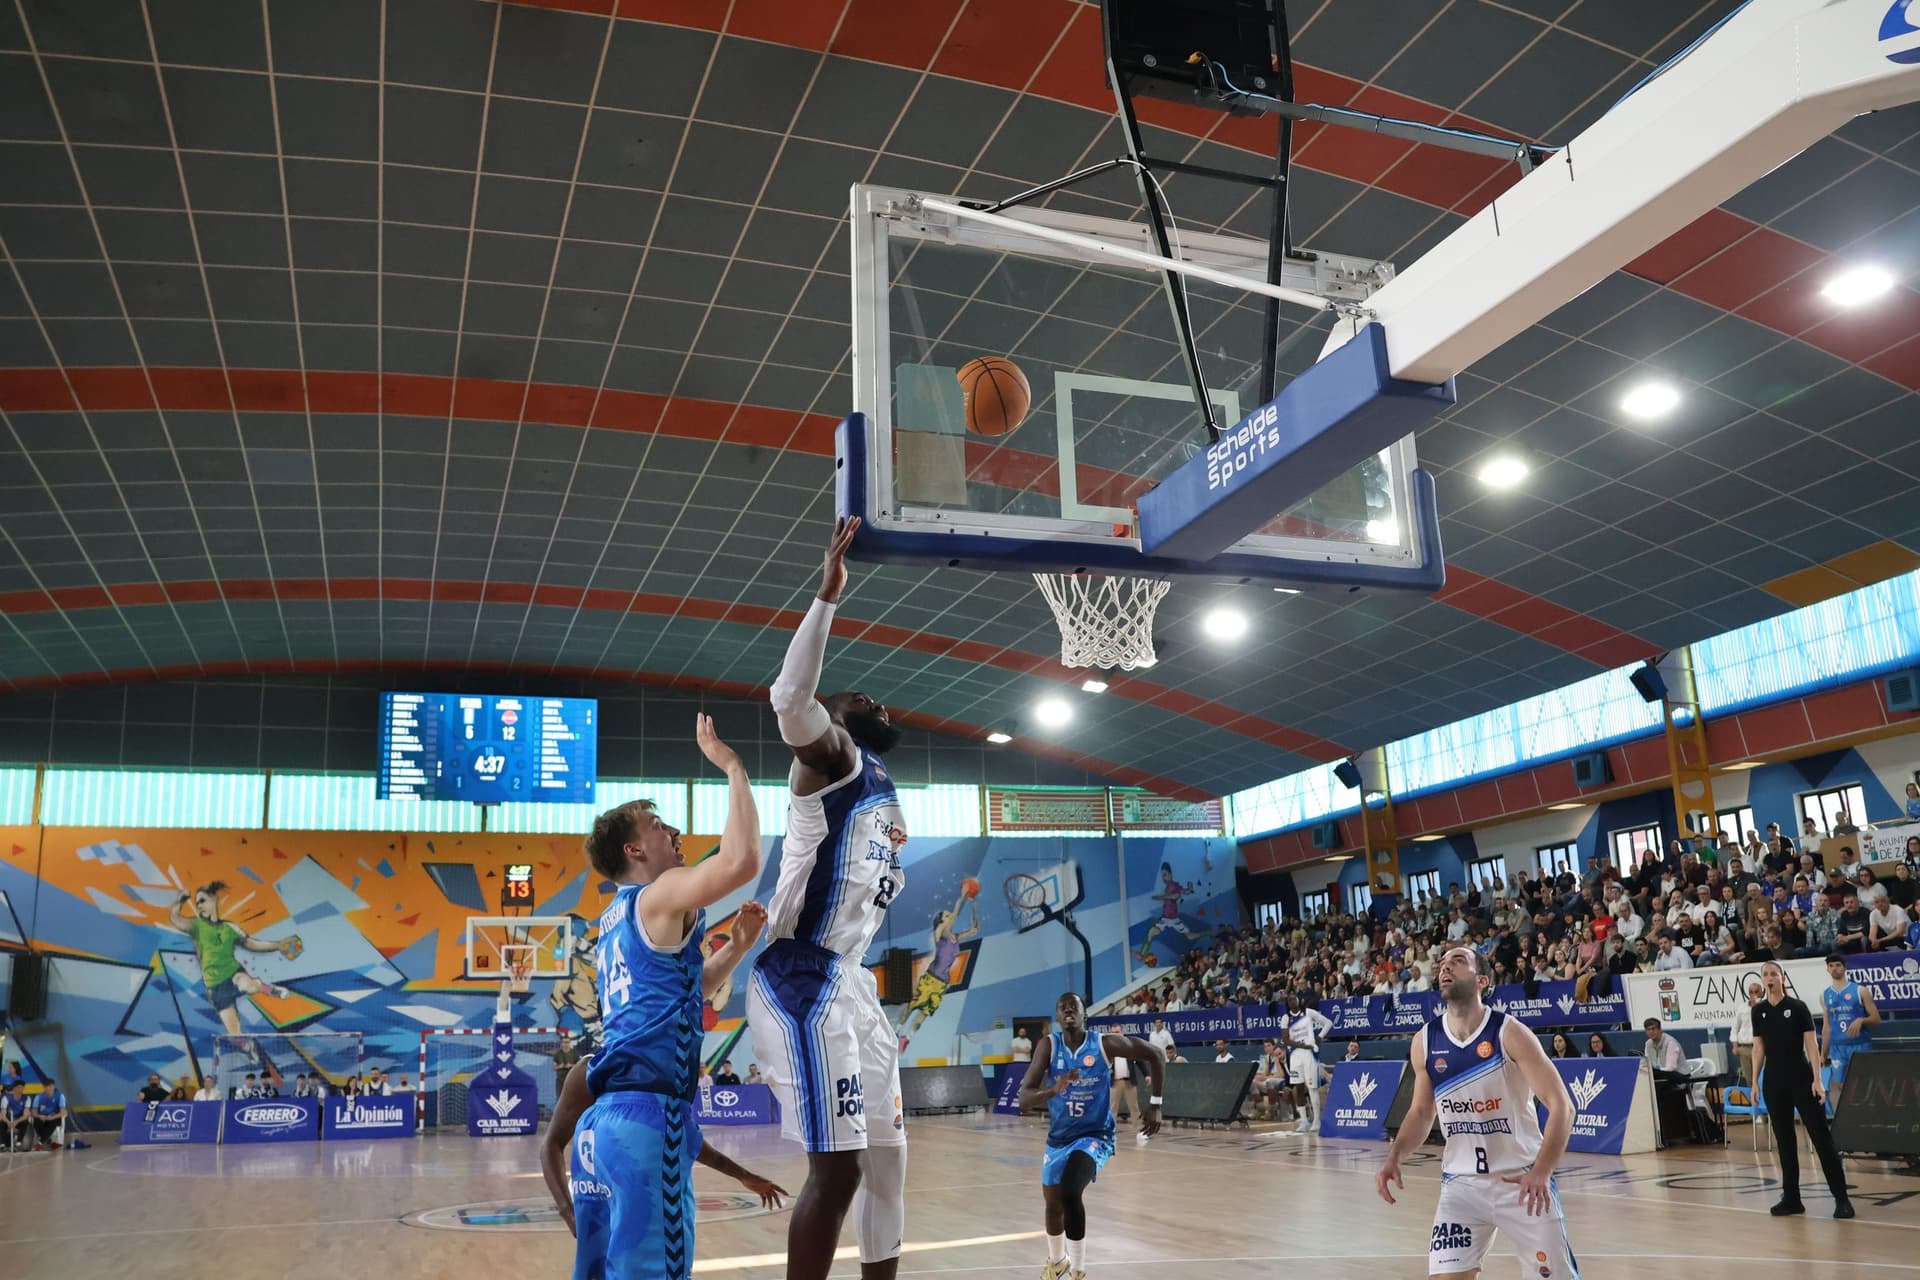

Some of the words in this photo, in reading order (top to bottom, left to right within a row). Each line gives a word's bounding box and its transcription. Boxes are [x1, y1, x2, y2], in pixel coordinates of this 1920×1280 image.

[1207, 405, 1278, 469] Schelde
[502, 726, 516, 740] 12
[474, 755, 505, 773] 4:37
[513, 778, 520, 789] 2
[507, 881, 530, 898] 13
[597, 932, 632, 1017] 14
[1689, 970, 1800, 1005] ZAMOA
[1509, 1000, 1527, 1010] CAJA
[1528, 998, 1552, 1009] RURAL
[1589, 1005, 1614, 1014] ZAMORA
[1520, 1009, 1542, 1017] ZAMORA
[1180, 1021, 1206, 1032] FADIS
[1344, 1018, 1370, 1028] ZAMORA
[1395, 1015, 1425, 1026] ZAMORA
[1840, 1021, 1847, 1033] 9
[1066, 1101, 1085, 1117] 15
[1441, 1097, 1502, 1115] Flexicar
[158, 1109, 187, 1123] AC
[244, 1108, 299, 1121] FERRERO
[335, 1106, 351, 1123] La
[355, 1105, 403, 1124] Opinión
[1335, 1109, 1352, 1119] CAJA
[1353, 1109, 1378, 1119] RURAL
[1576, 1114, 1608, 1127] RURAL
[477, 1119, 498, 1128] CAJA
[500, 1118, 531, 1127] RURAL
[1346, 1119, 1368, 1127] ZAMORA
[1443, 1118, 1512, 1137] FUENLABRADA
[1572, 1127, 1596, 1136] AMORA
[1475, 1146, 1489, 1174] 8
[1430, 1236, 1472, 1252] JOHNS
